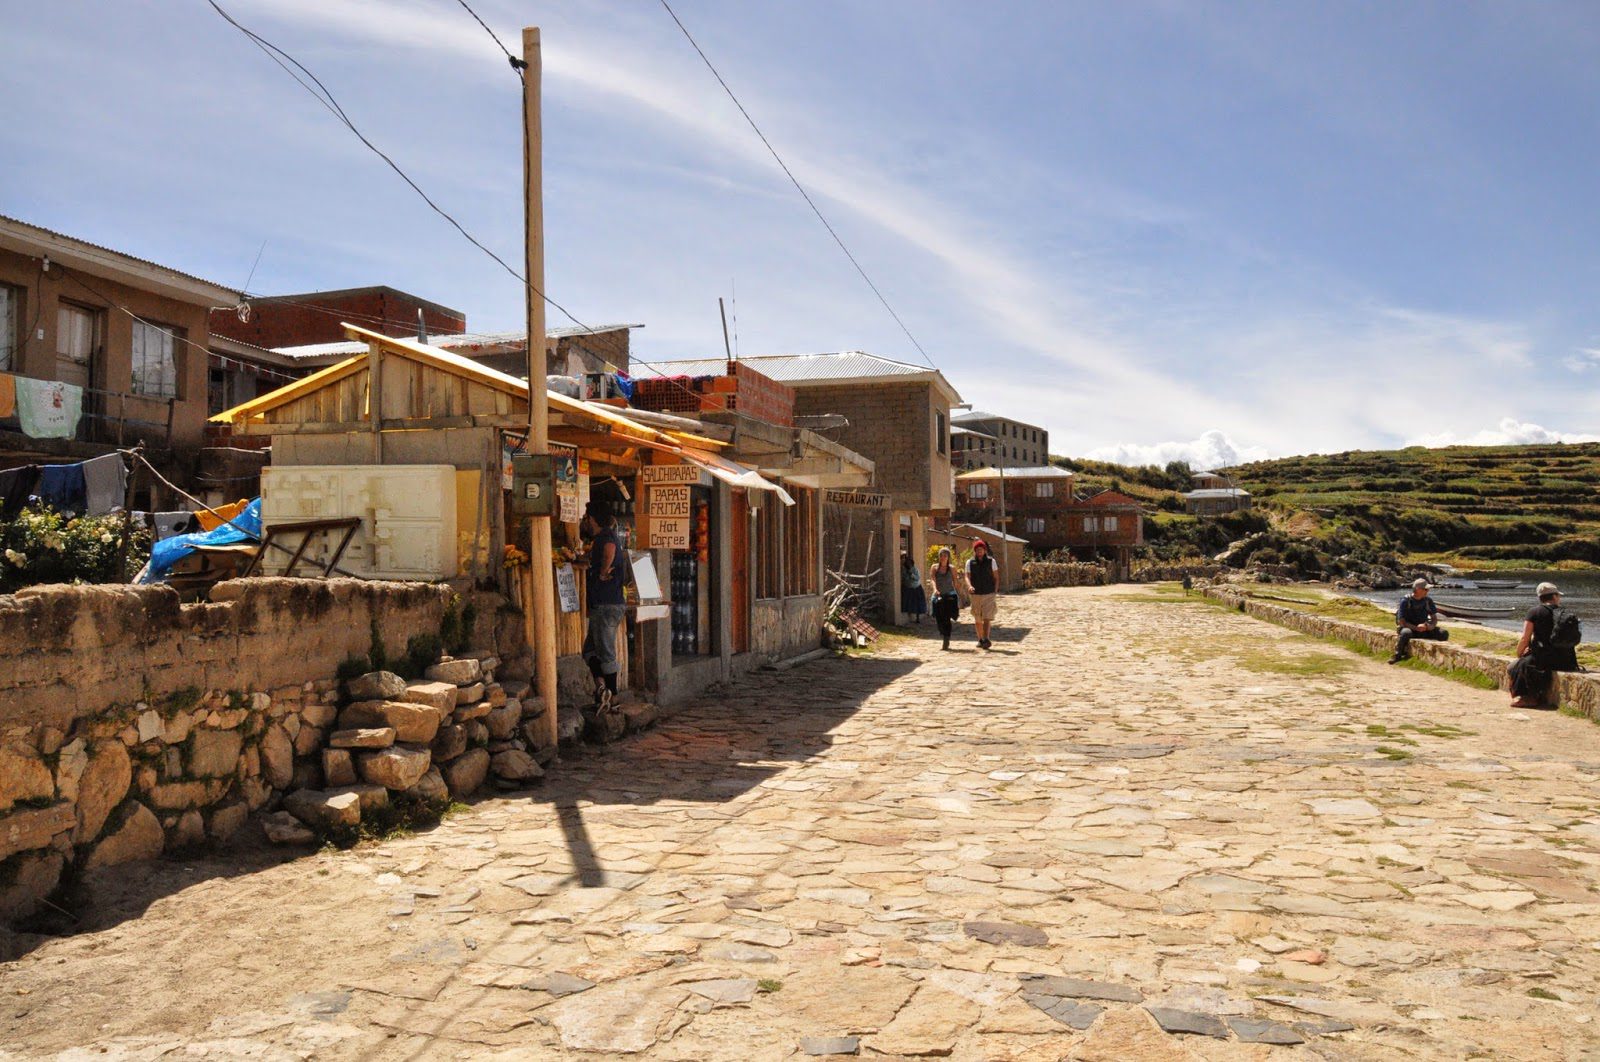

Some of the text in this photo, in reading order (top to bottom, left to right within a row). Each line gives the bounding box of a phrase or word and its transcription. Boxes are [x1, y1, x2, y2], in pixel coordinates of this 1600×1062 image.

[643, 466, 697, 482] SALCHIPAPAS
[654, 488, 688, 501] PAPAS
[826, 491, 885, 507] RESTAURANT
[650, 502, 688, 515] FRITAS
[659, 520, 678, 532] Hot
[651, 533, 685, 547] Coffee
